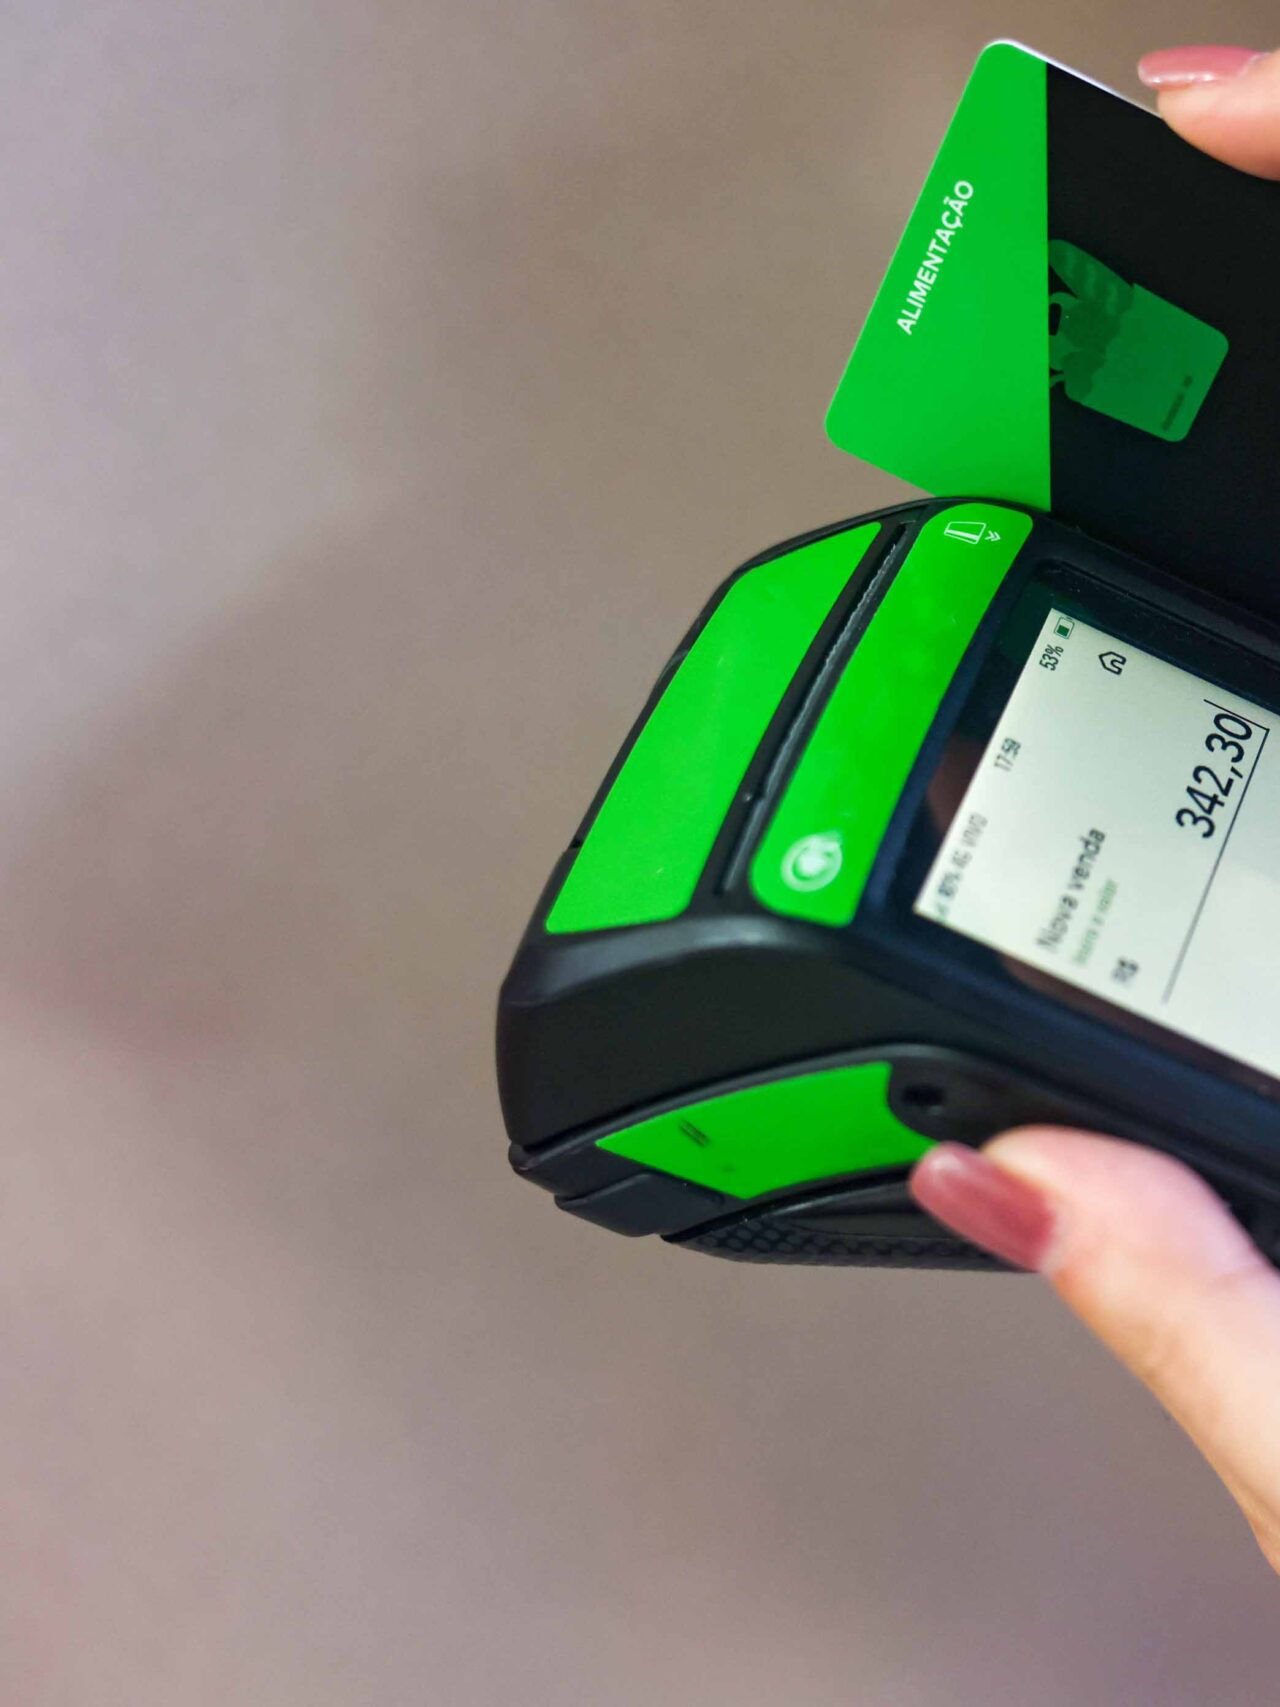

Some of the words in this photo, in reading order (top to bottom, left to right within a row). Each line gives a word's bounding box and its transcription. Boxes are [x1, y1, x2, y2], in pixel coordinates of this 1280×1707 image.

[896, 180, 974, 335] ALIMENTAÇÃO
[1039, 643, 1065, 672] 53%
[1175, 713, 1254, 839] 342,30
[1036, 893, 1079, 953] Nova
[1068, 827, 1107, 892] venda
